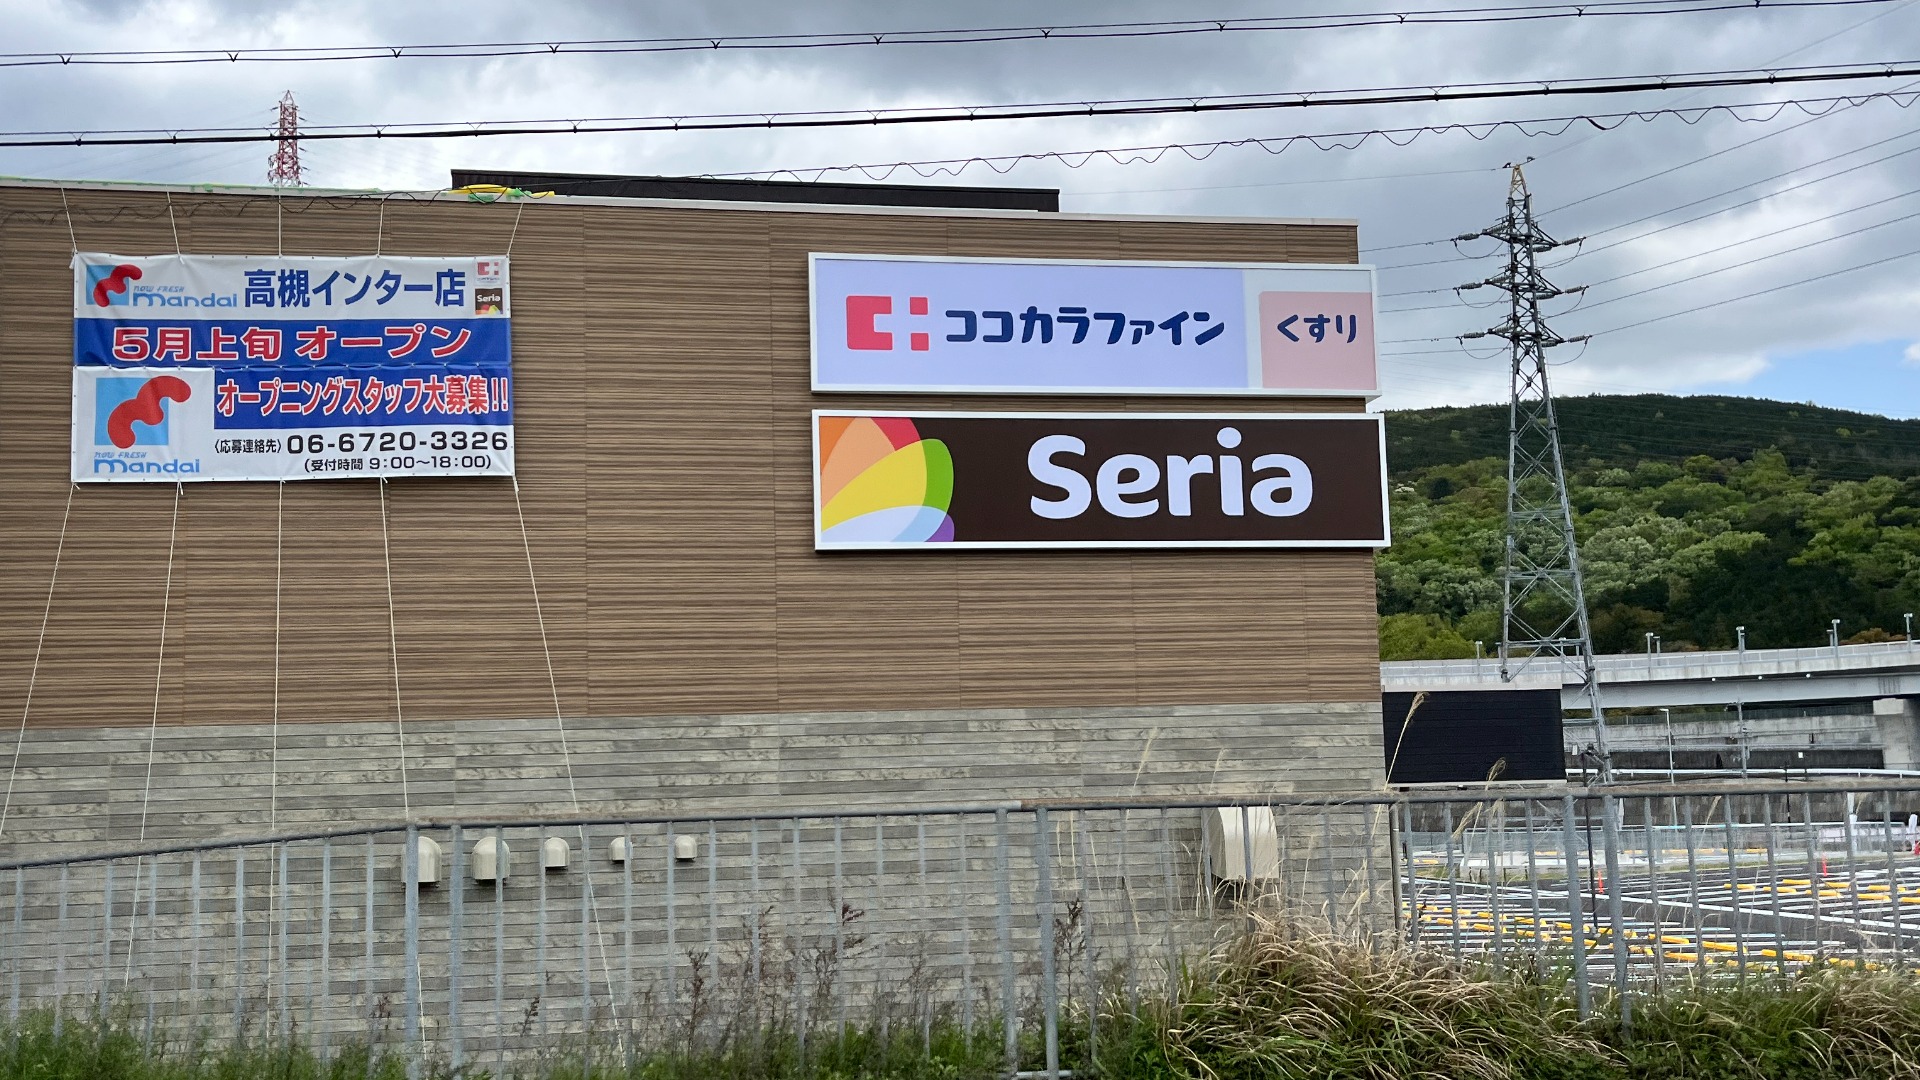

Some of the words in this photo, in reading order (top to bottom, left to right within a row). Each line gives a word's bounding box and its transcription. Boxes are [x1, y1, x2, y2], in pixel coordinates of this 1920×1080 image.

[133, 293, 238, 307] mandai
[244, 269, 466, 307] 高槻インター店
[477, 294, 501, 302] Seria
[112, 327, 282, 361] 5月上旬
[295, 323, 471, 359] オープン
[945, 306, 1225, 345] ココカラファイン
[1277, 314, 1359, 343] くすり
[217, 374, 509, 417] オープニングスタッフ大募集!!
[287, 431, 508, 454] 06-6720-3326
[94, 459, 200, 473] mandai
[1027, 427, 1314, 519] Seria
